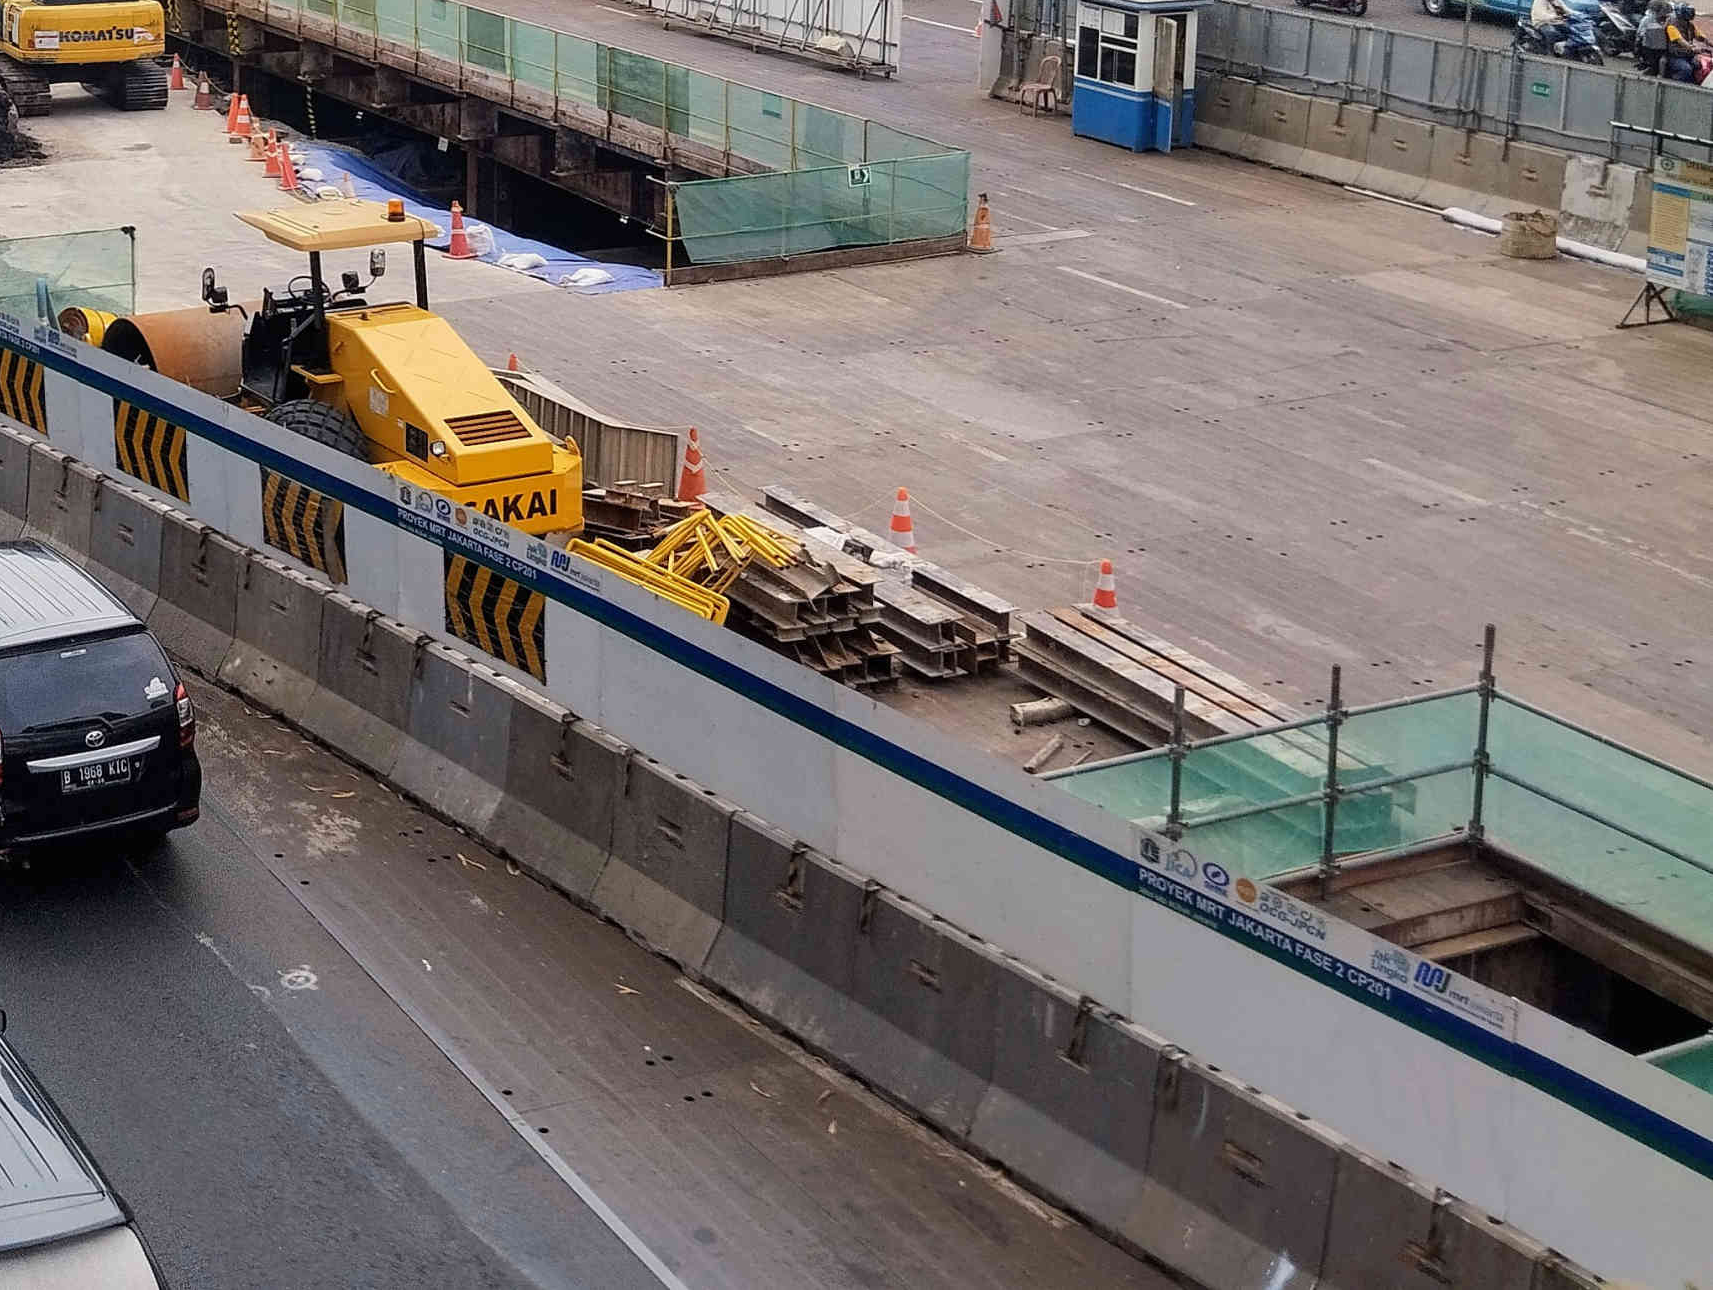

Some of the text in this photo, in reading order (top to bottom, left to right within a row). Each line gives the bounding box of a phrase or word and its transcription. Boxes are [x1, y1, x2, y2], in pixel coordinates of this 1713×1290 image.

[58, 26, 135, 43] KOMATSU
[464, 488, 558, 523] AKAI
[398, 508, 429, 531] PROYEK
[429, 520, 446, 538] MRT
[447, 530, 483, 555] JAKARTA
[483, 546, 505, 566] FASE
[511, 559, 538, 580] CP201
[63, 770, 71, 785] B
[79, 764, 103, 782] 1968
[108, 759, 128, 775] KIC
[1138, 868, 1194, 905] PROYEK
[1195, 895, 1226, 920] MRT
[1227, 909, 1294, 955] JAKARTA
[1294, 943, 1334, 973] FASE
[1335, 962, 1346, 979] 2
[1346, 969, 1392, 1002] CP201
